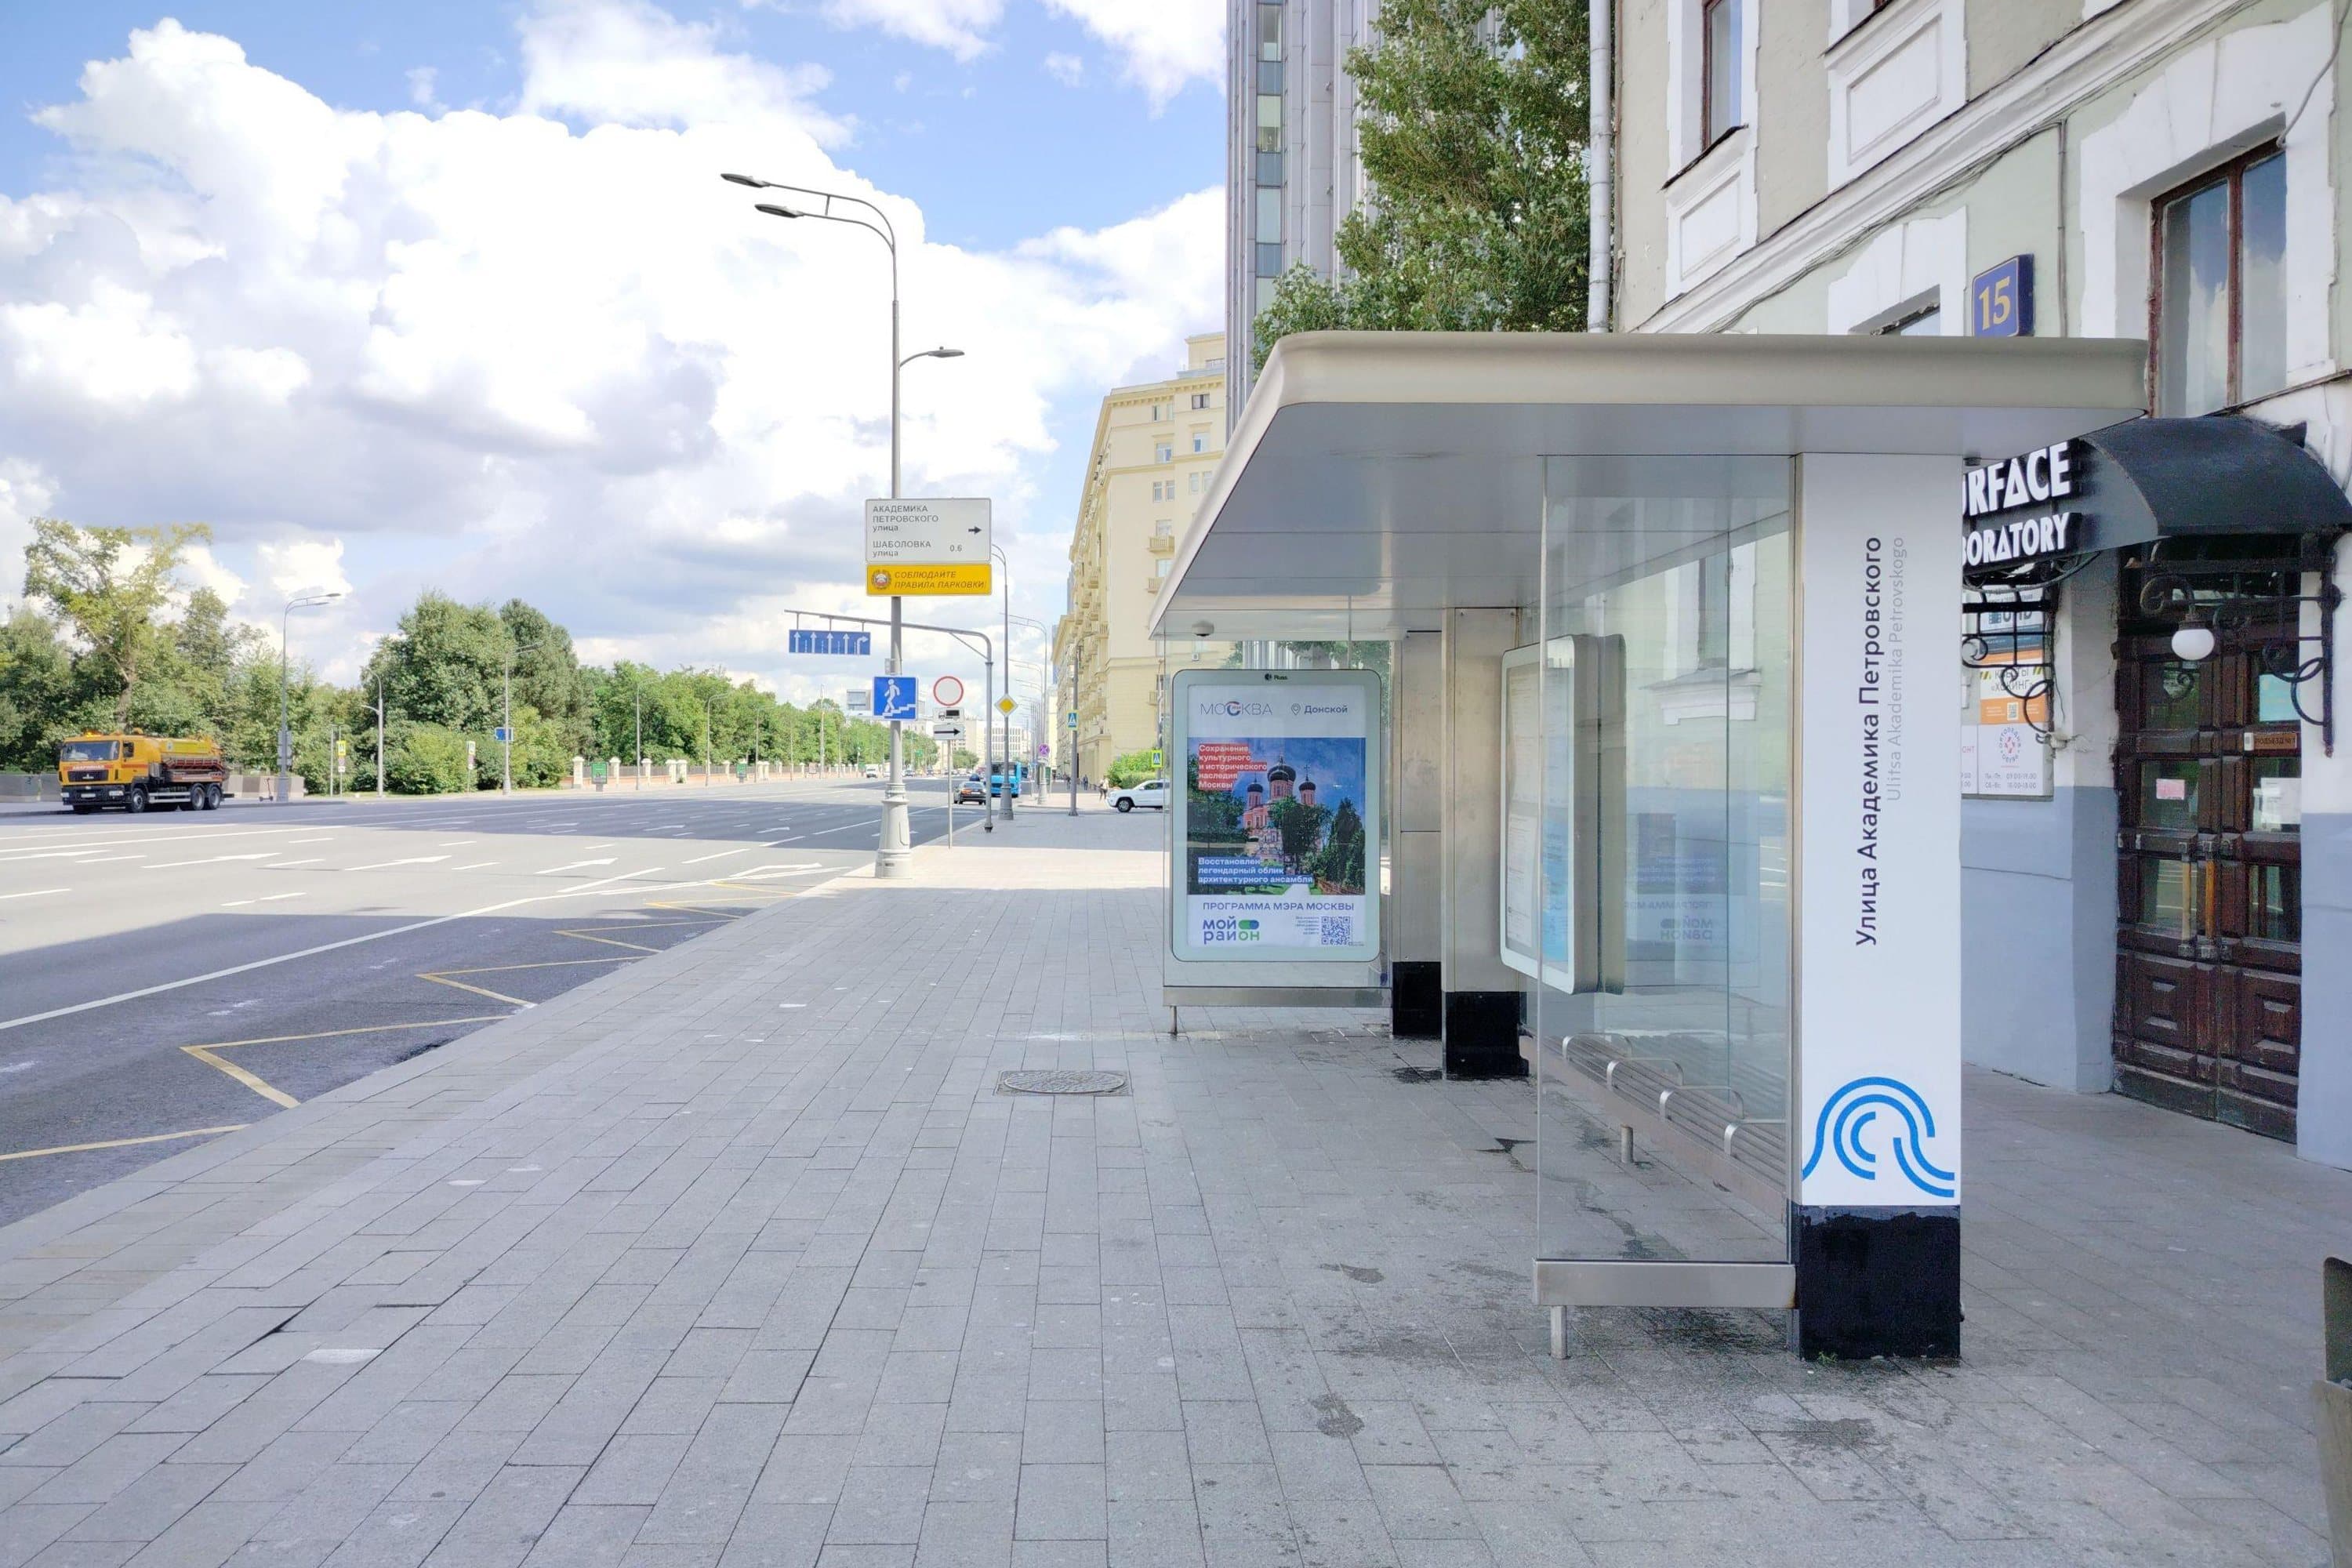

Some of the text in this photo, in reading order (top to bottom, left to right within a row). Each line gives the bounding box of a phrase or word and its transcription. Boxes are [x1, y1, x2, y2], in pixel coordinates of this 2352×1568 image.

[1979, 276, 2011, 331] 15
[895, 571, 956, 579] СОБЛЮДАЙТЕ
[1886, 537, 1907, 801] Ulitsa Akademika Petrovskogo
[1200, 701, 1272, 717] МОСКВА
[1304, 705, 1348, 714] Донской
[1856, 537, 1885, 946] Улица Академика Петровского
[1198, 866, 1255, 875] легендарный
[1198, 875, 1313, 884] архитектурного ансамбля
[1203, 916, 1236, 930] мой
